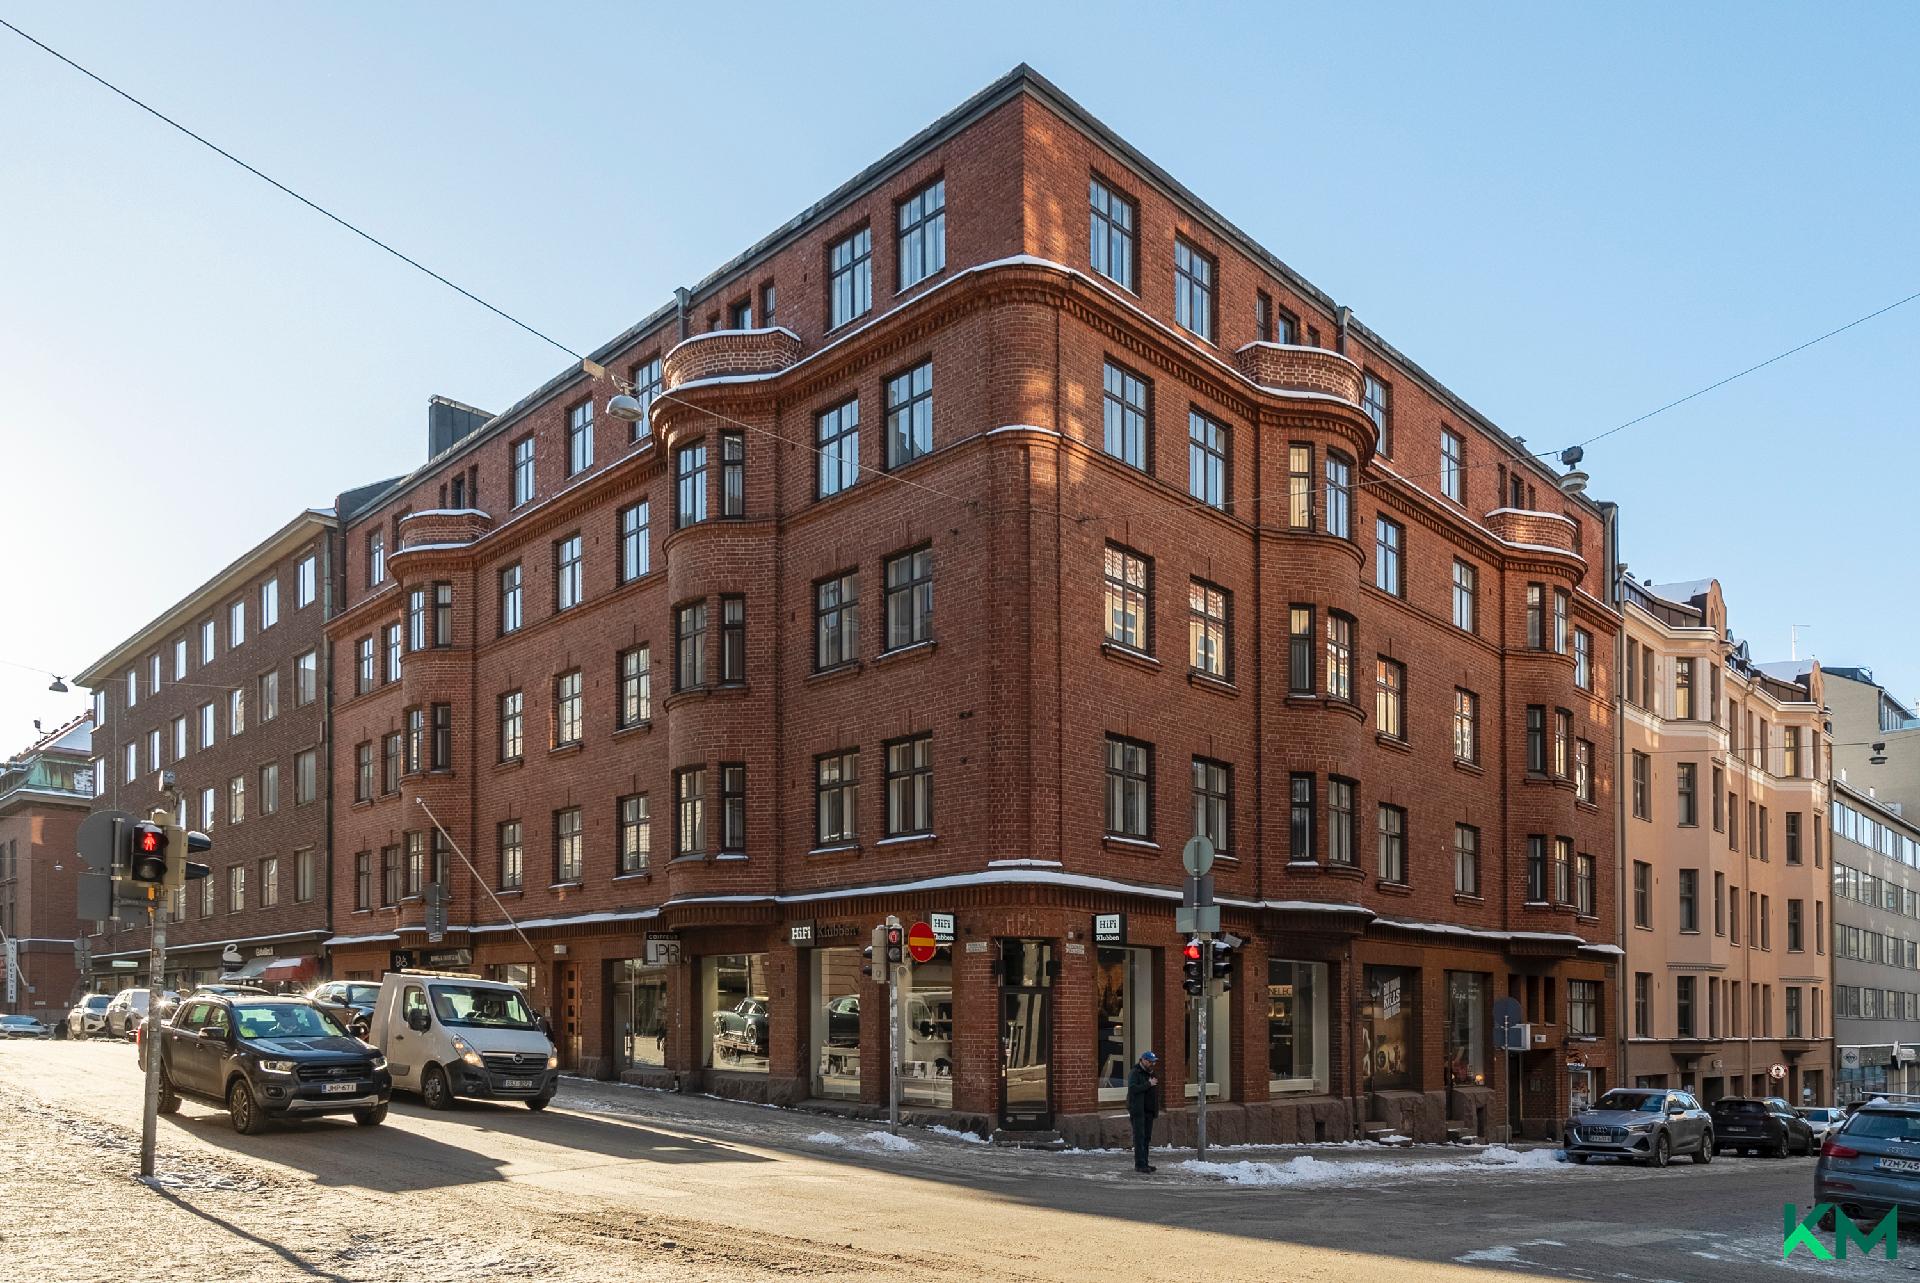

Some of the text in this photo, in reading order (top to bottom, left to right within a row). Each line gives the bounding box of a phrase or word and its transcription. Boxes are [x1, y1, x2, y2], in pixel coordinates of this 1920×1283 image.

[934, 919, 951, 928] HiFi
[1099, 919, 1117, 929] HiFi
[791, 926, 856, 940] HiFi Klubben
